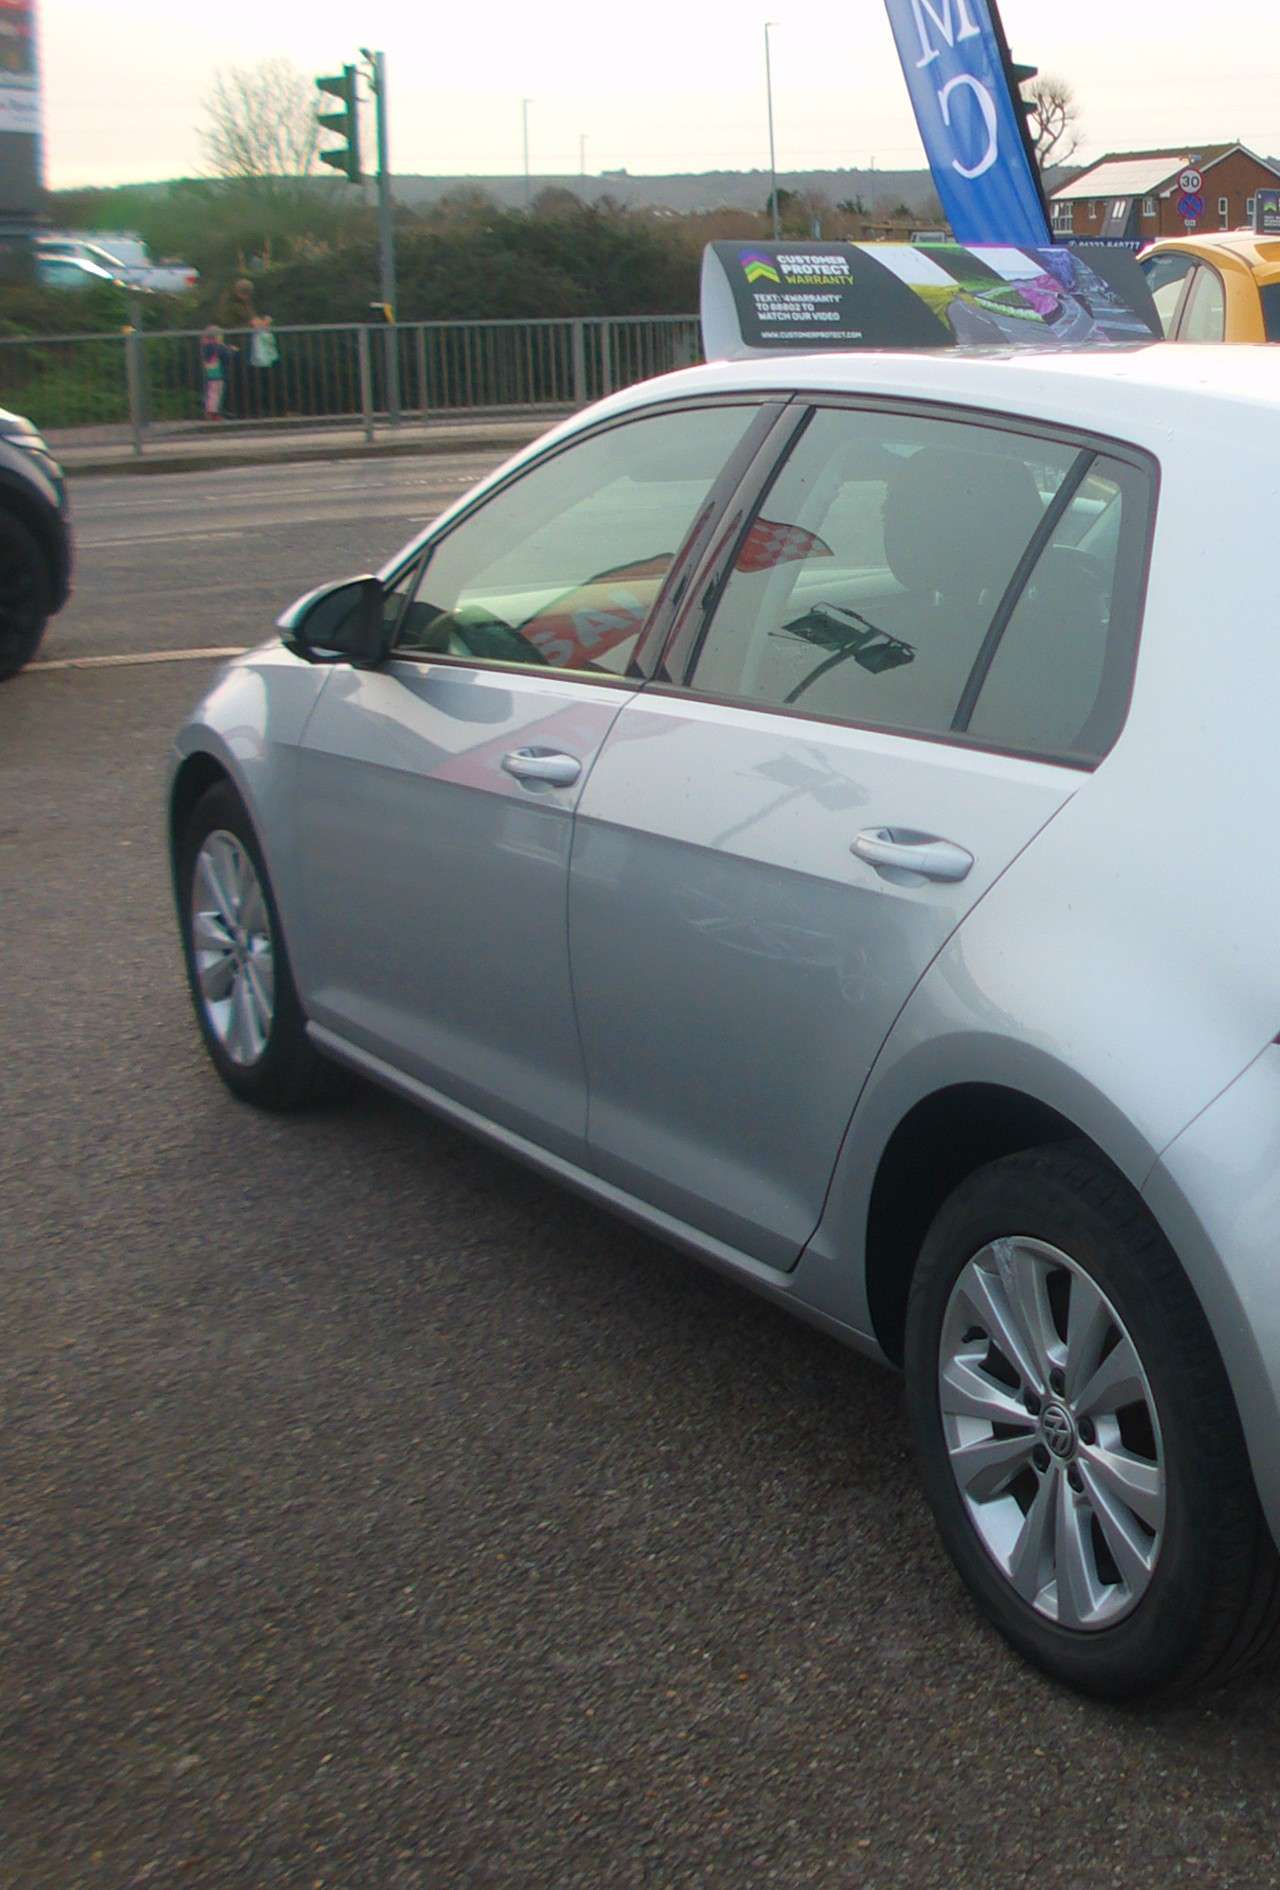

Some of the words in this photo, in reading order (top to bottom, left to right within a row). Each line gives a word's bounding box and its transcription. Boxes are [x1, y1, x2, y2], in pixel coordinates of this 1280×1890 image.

[1182, 175, 1200, 188] 30
[776, 254, 847, 265] CUSTOMER
[780, 264, 850, 275] PROTECT
[785, 275, 854, 286] WARRANTY
[756, 303, 769, 311] TO
[802, 304, 815, 312] TO
[757, 312, 791, 321] WATCH
[792, 312, 813, 321] OUR
[813, 312, 841, 321] VIDEO
